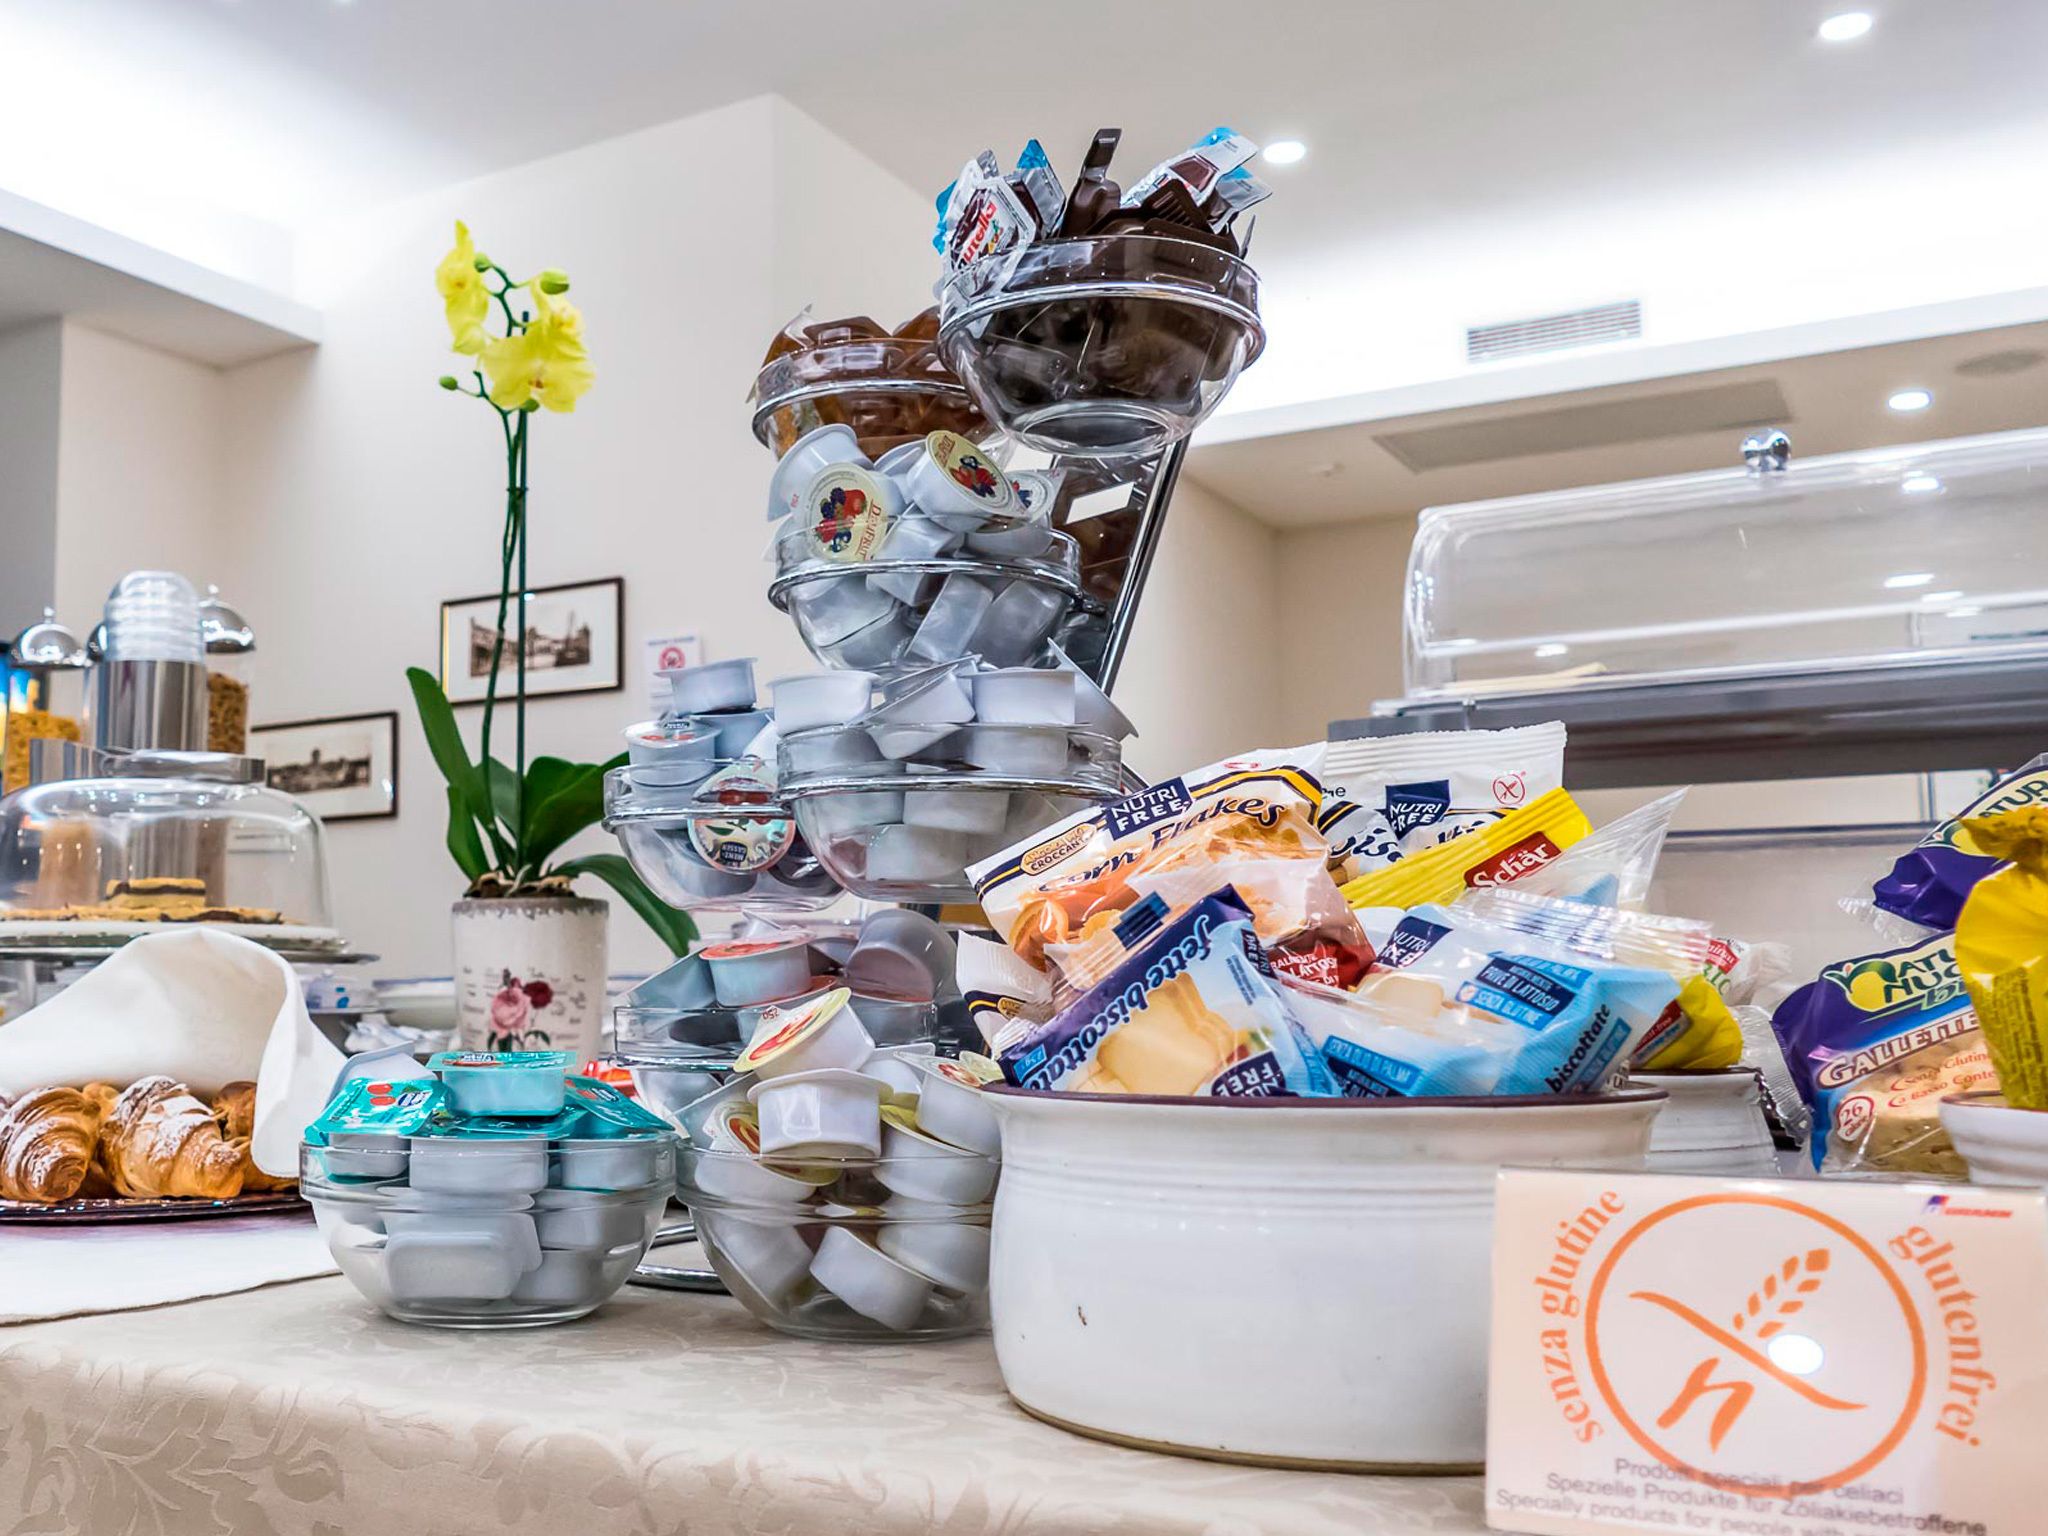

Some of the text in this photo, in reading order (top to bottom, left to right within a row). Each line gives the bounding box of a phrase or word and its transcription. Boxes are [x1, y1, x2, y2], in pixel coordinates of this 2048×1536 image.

[1112, 785, 1177, 818] NUTRI
[1390, 802, 1442, 820] NUTRI
[1150, 797, 1285, 851] Flakes
[1473, 838, 1551, 888] Schär
[1511, 981, 1560, 1012] LATTOSIO
[1545, 1003, 1611, 1092] biscottate
[1944, 1051, 1988, 1070] Glutin
[1842, 1103, 1863, 1126] 26
[1532, 1190, 1625, 1444] senza glutine
[1887, 1225, 1998, 1447] glutenfrei
[1496, 1489, 1584, 1521] Specially
[1589, 1498, 1677, 1528] products
[1684, 1509, 1713, 1528] for
[1546, 1472, 1637, 1500] Spezielle
[1643, 1483, 1738, 1508] Produkte
